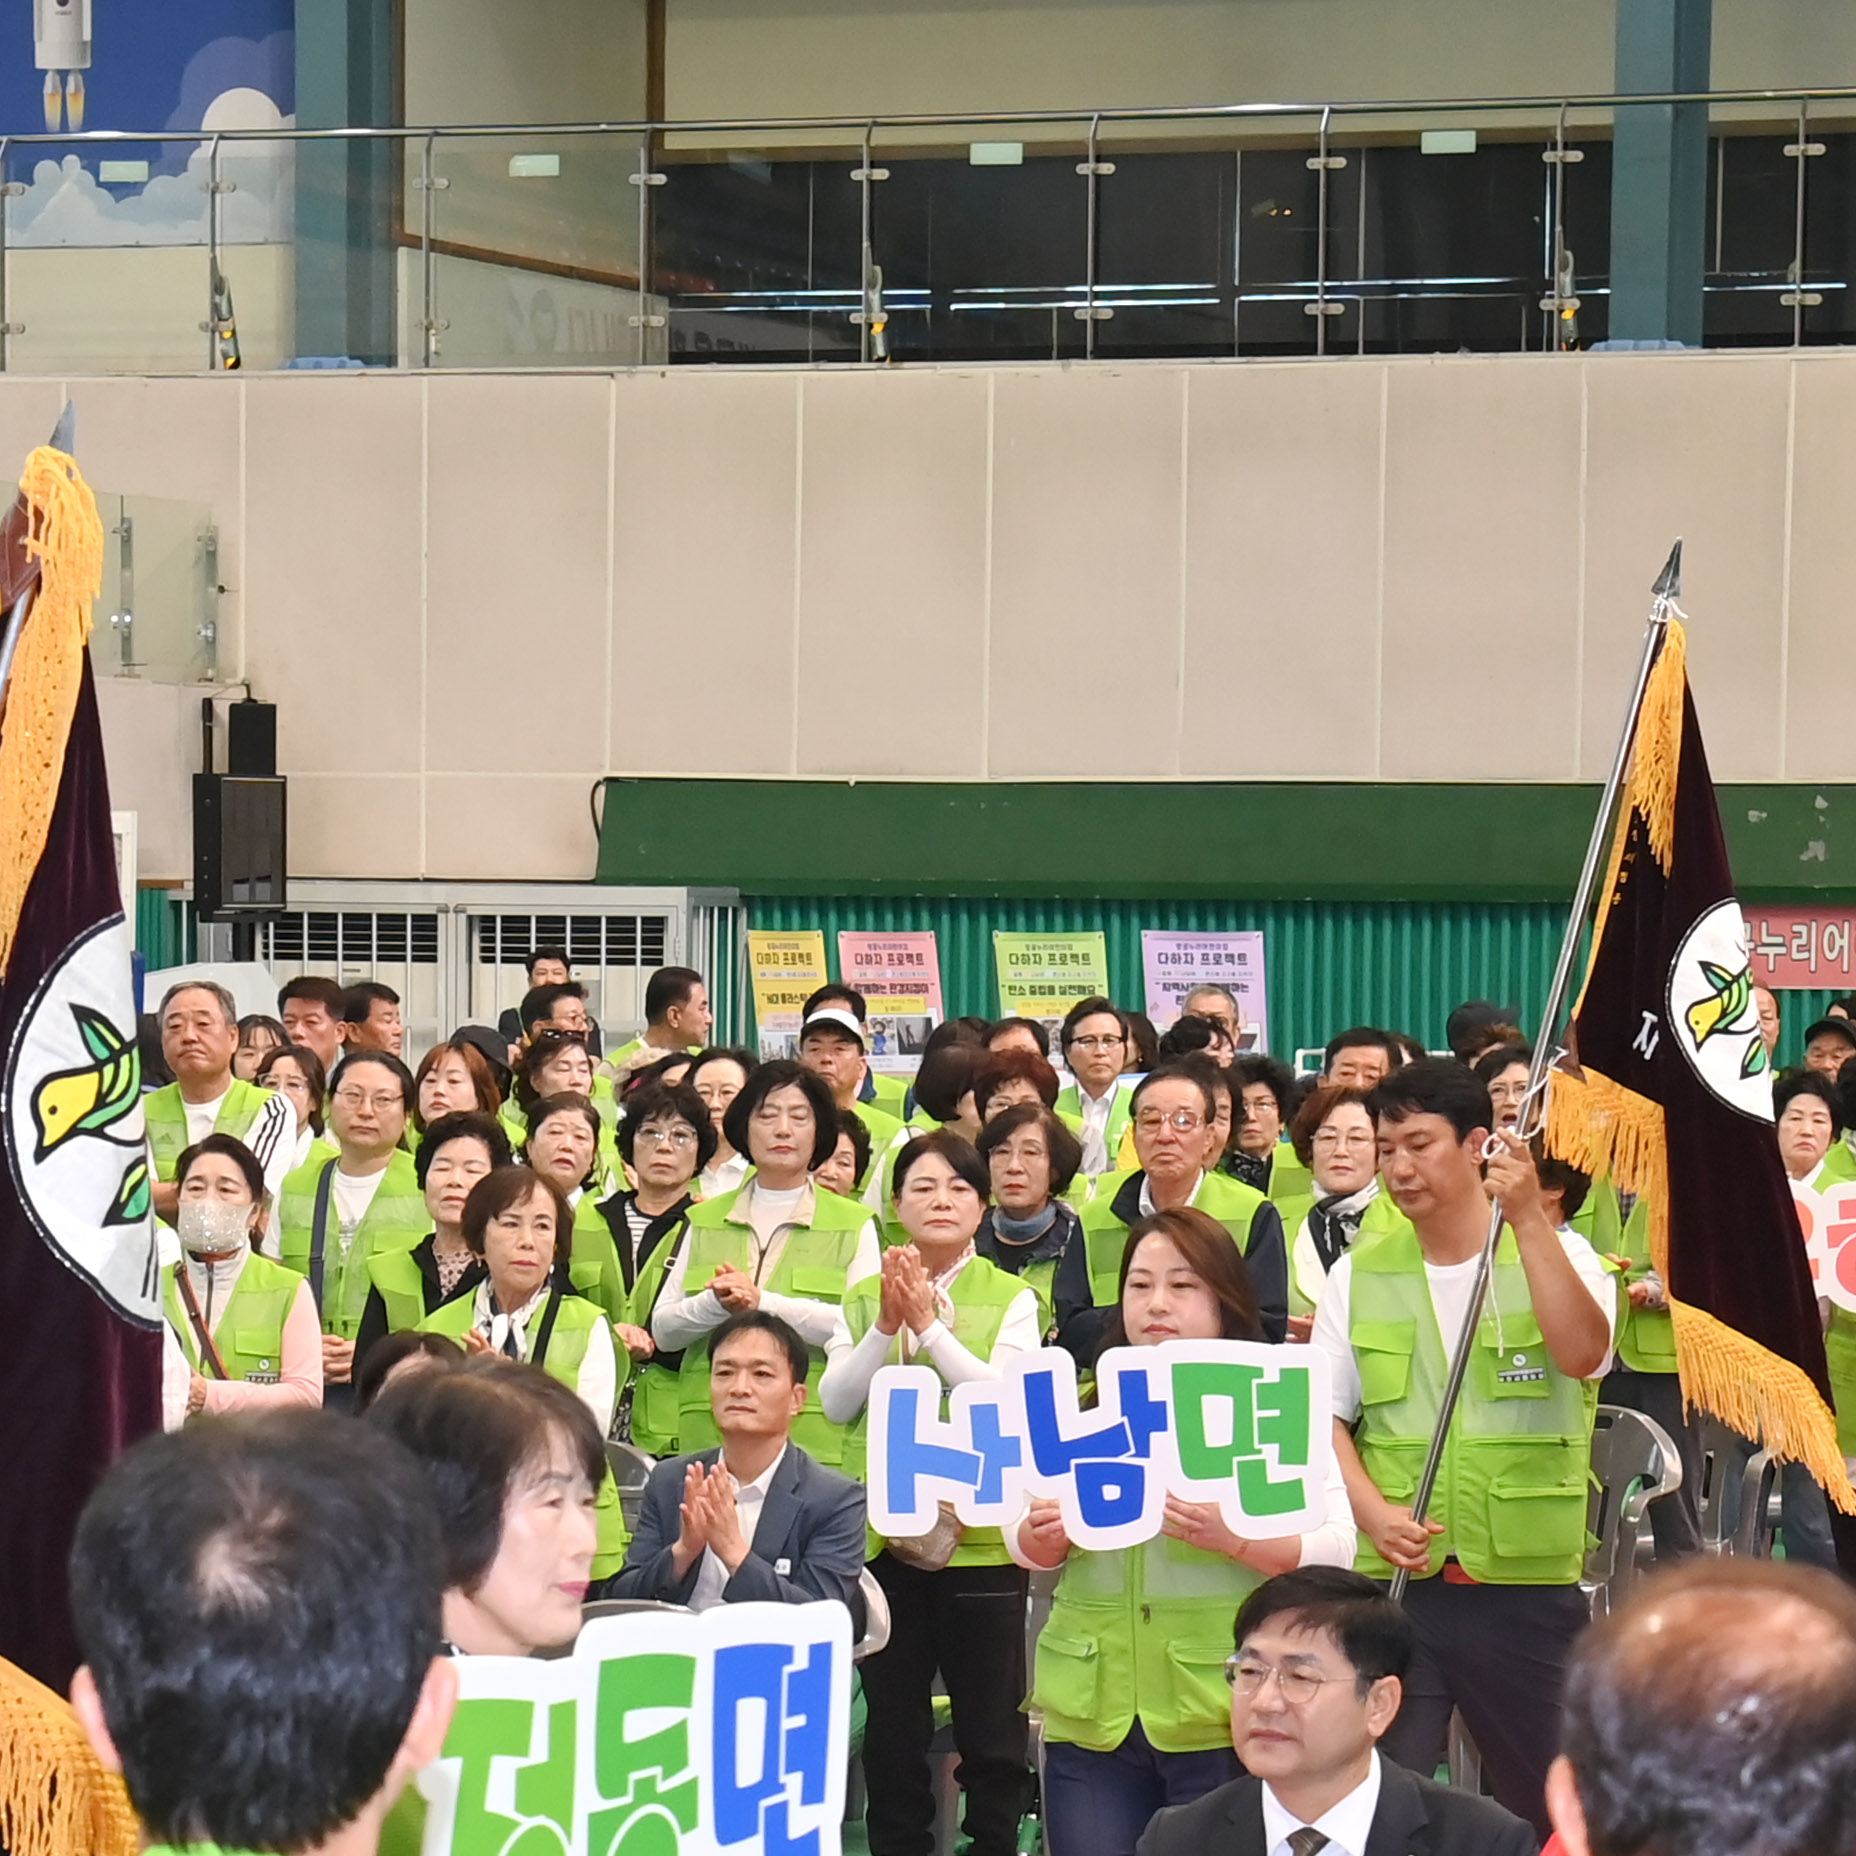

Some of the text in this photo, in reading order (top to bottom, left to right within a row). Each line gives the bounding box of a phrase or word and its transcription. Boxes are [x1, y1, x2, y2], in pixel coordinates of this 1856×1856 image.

[757, 953, 812, 965] 다하자 프로젝트
[855, 953, 924, 965] 다하자 프로젝트
[1009, 953, 1091, 965] 다하자 프로젝트
[1158, 952, 1247, 965] 다하자 프로젝트
[887, 1362, 1310, 1529] 사남면
